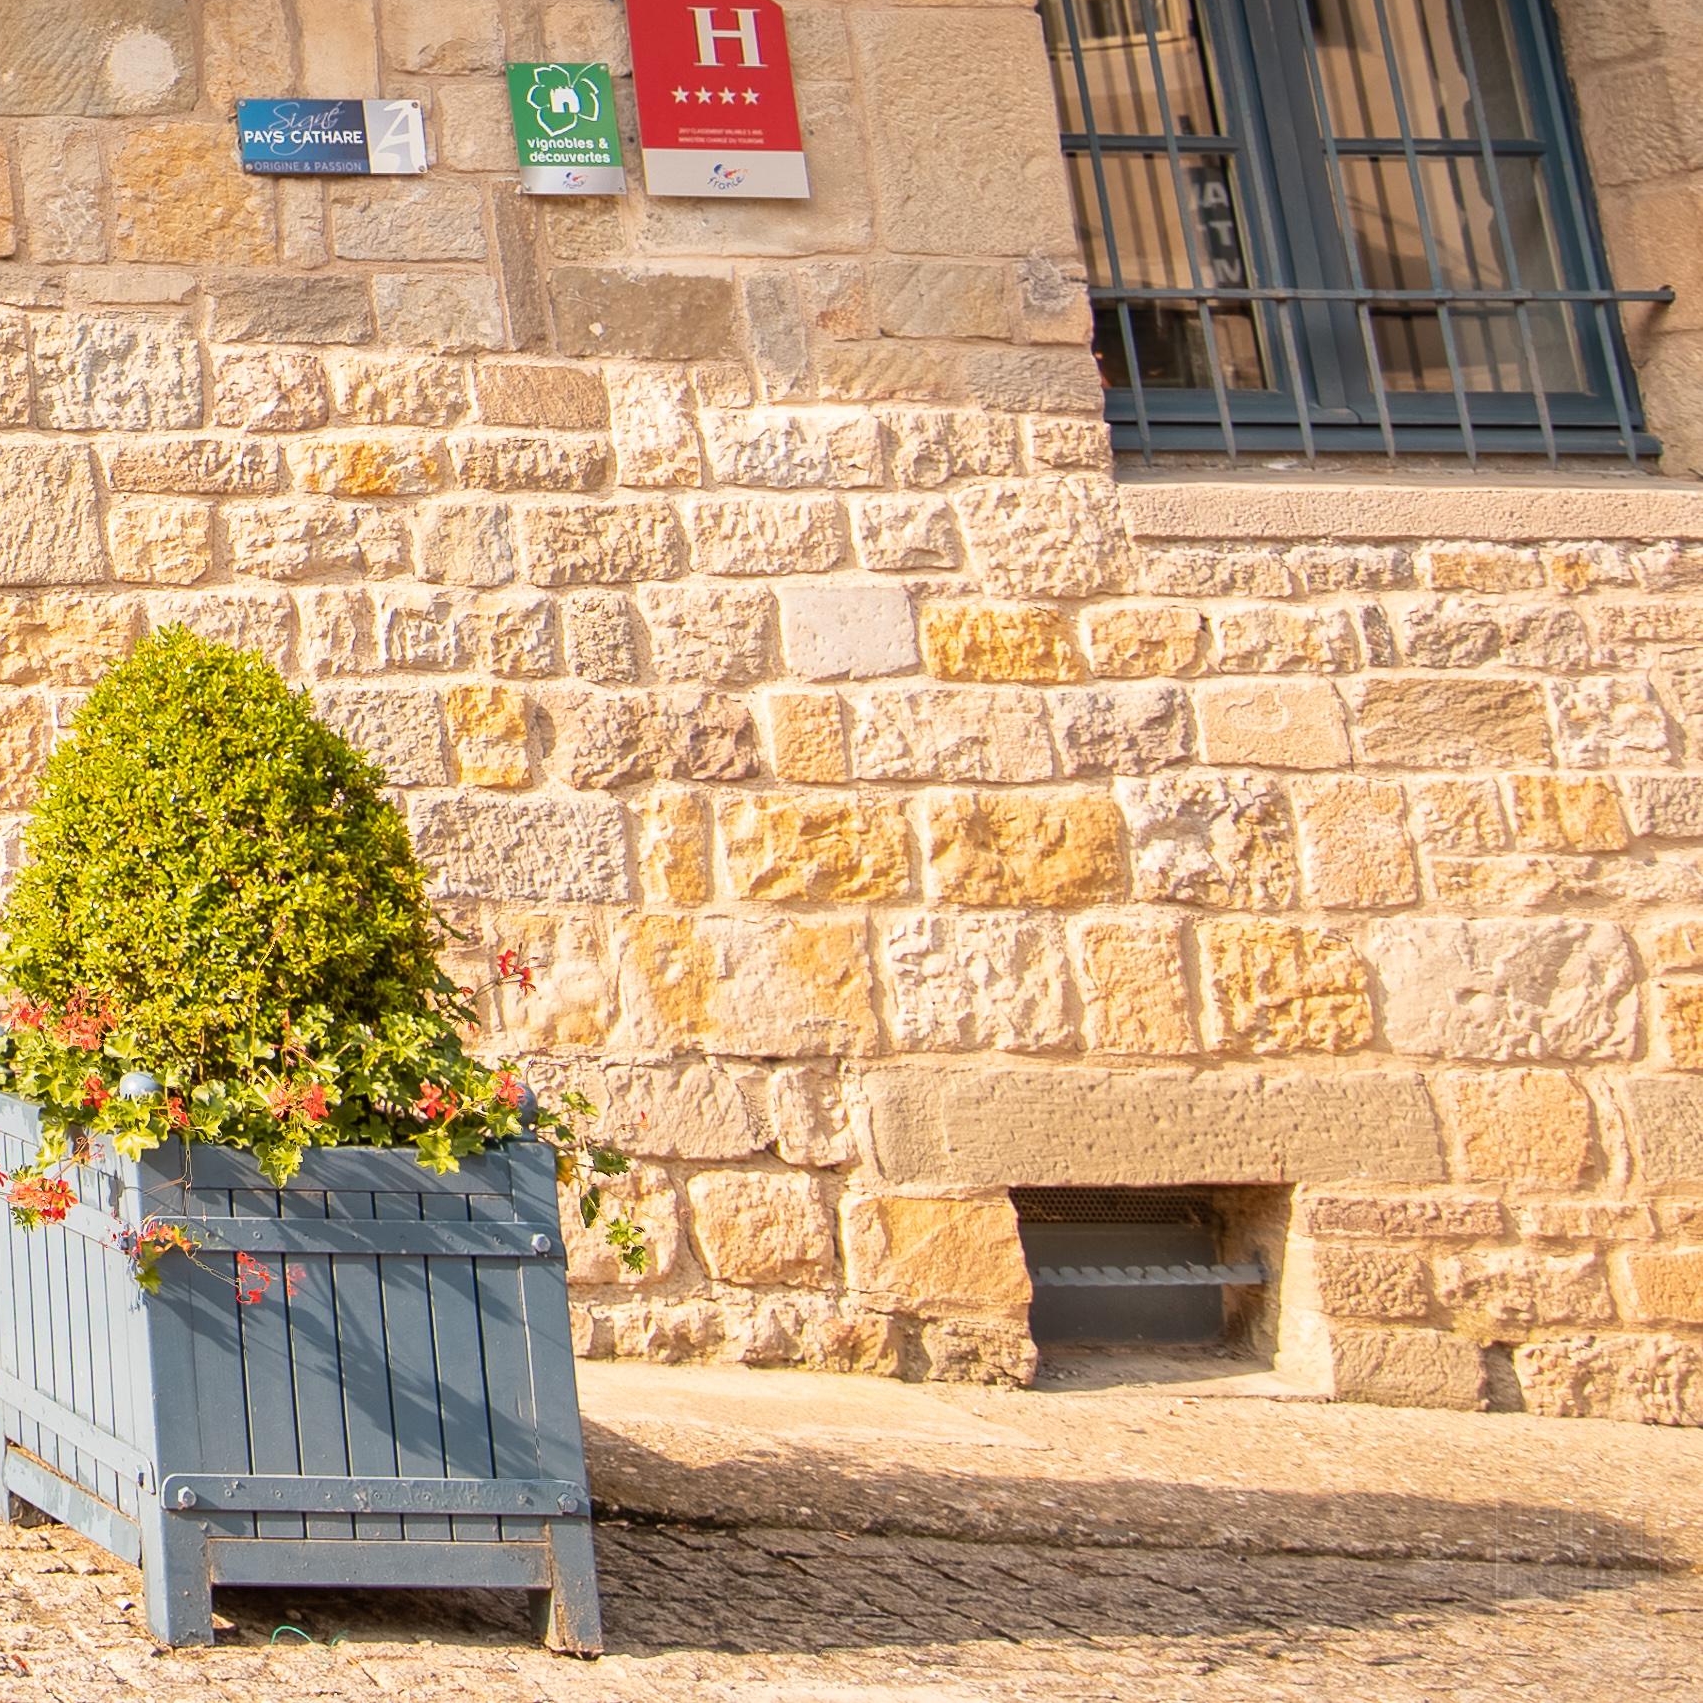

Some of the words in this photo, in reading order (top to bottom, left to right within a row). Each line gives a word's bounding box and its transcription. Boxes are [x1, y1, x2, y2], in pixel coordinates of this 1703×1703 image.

[686, 6, 769, 68] H
[244, 130, 285, 144] PAYS
[290, 130, 364, 144] CATHARE
[526, 137, 595, 152] vignobles
[598, 137, 610, 150] &
[528, 151, 611, 164] découvertes
[254, 161, 302, 172] ORIGINE
[303, 162, 311, 172] &
[314, 161, 362, 172] PASSION
